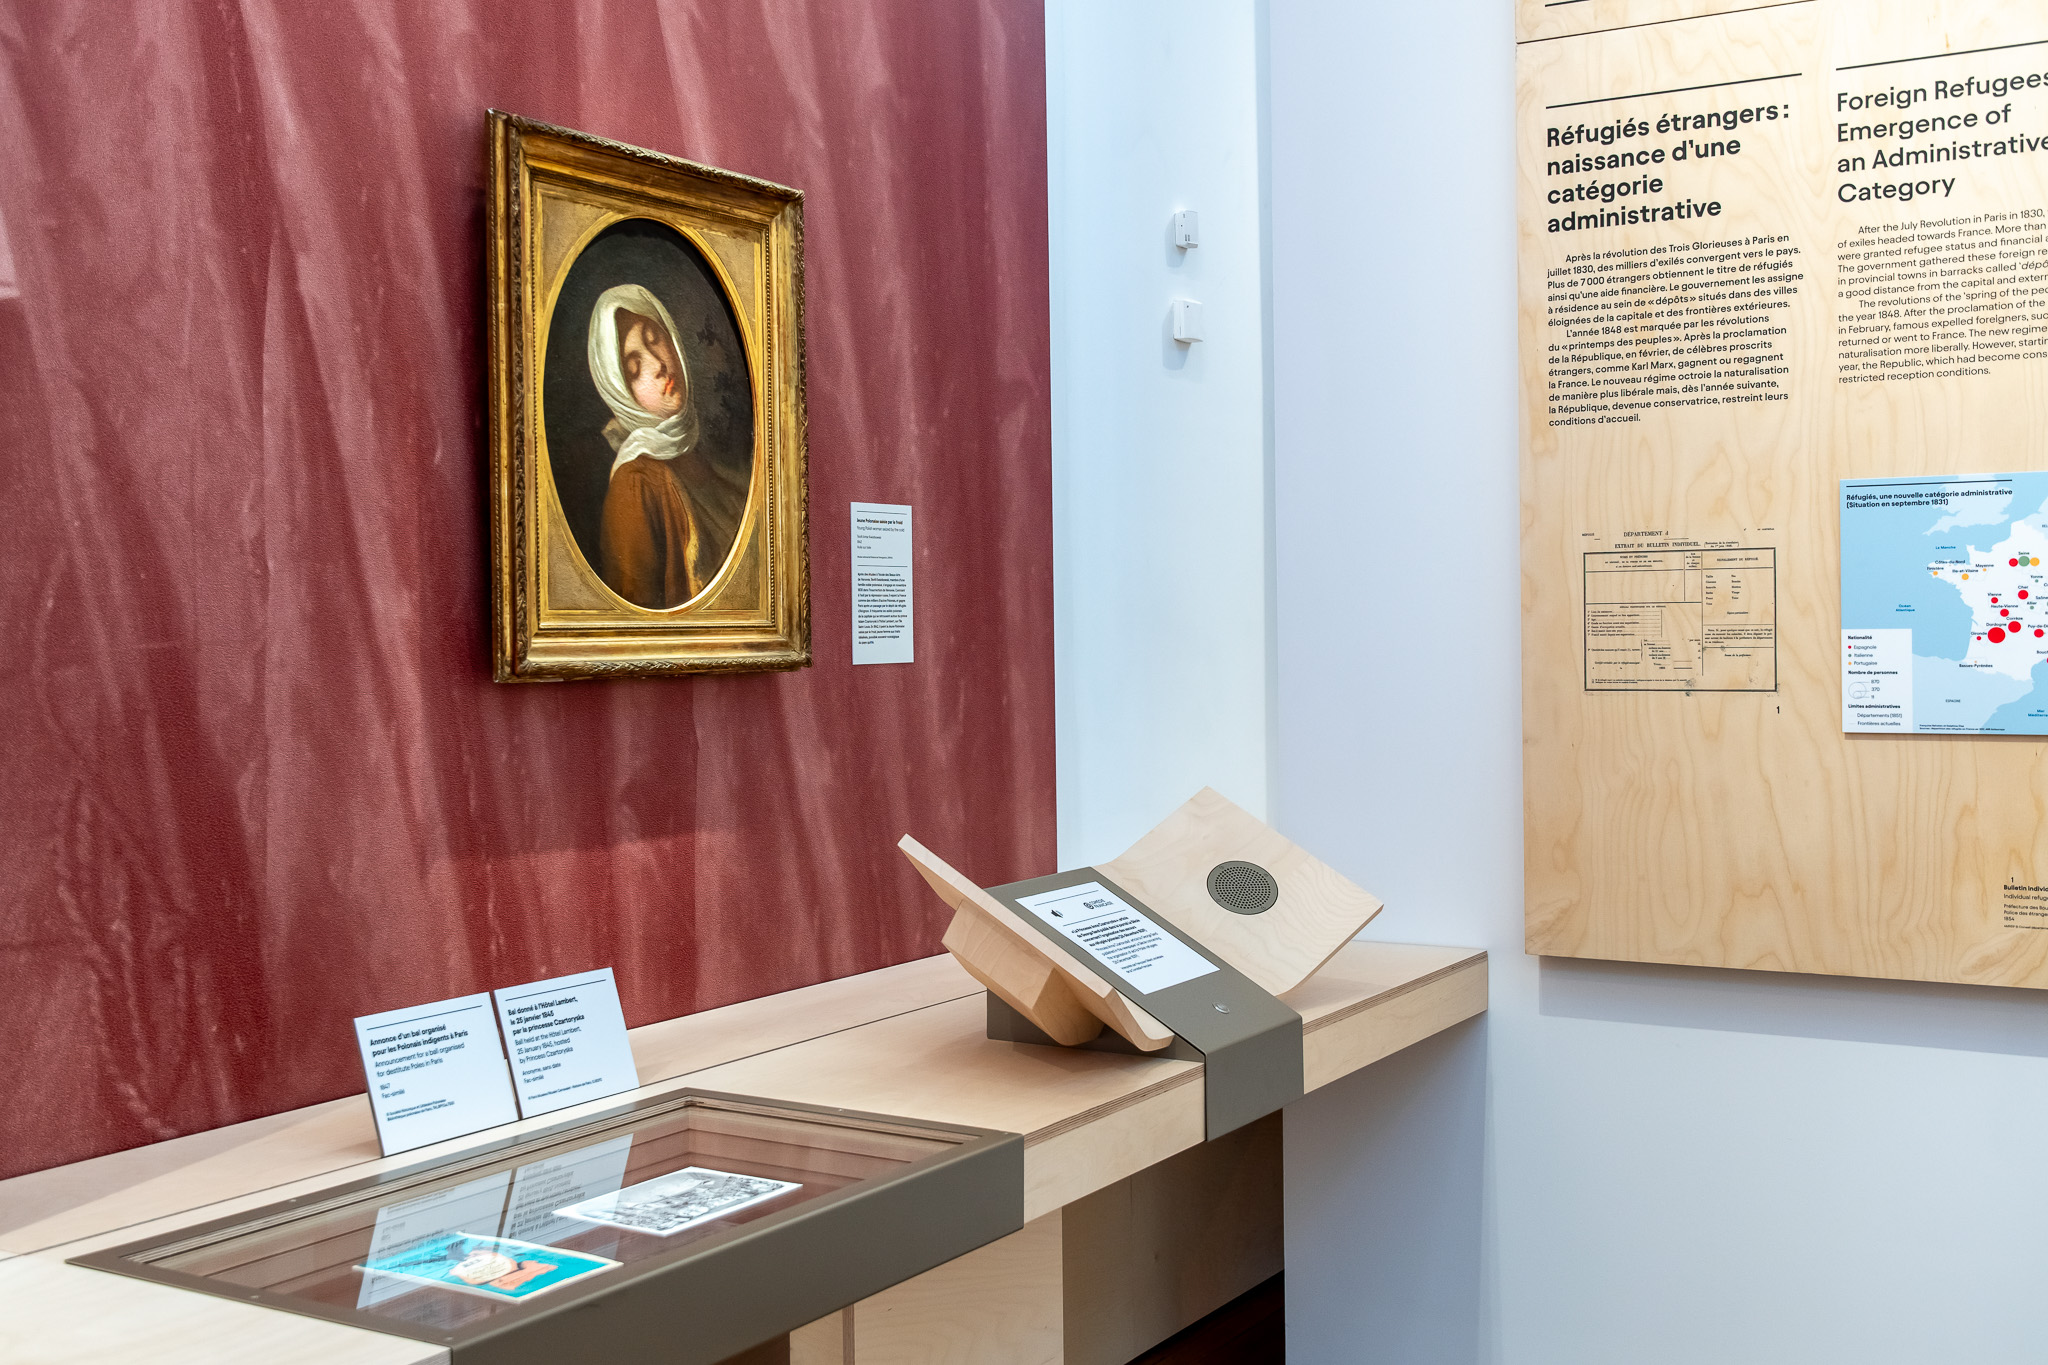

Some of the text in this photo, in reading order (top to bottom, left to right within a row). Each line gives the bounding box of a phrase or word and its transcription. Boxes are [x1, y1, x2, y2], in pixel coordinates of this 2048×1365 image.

[1837, 87, 1927, 112] Foreign
[1547, 118, 1649, 147] Réfugiés
[1656, 104, 1778, 134] étrangers
[1837, 103, 2012, 142] Emergence of
[1547, 140, 1741, 176] naissance d'une
[1838, 156, 1865, 172] an
[1547, 174, 1664, 204] catégorie
[1838, 178, 1956, 202] Category
[1548, 199, 1722, 233] administrative
[1858, 209, 2045, 234] After the July Revolution in Paris in 1830,
[1565, 253, 1591, 264] Après
[1593, 252, 1600, 260] la
[1603, 248, 1648, 259] révolution
[1650, 246, 1667, 255] des
[1669, 243, 1690, 253] Trois
[1692, 240, 1742, 251] Glorieuses
[1745, 237, 1750, 246] à
[1753, 235, 1775, 245] Paris
[1547, 267, 1571, 279] juillet
[1573, 265, 1595, 275] 1830,
[1597, 264, 1614, 272] des
[1616, 261, 1648, 271] milliers
[1650, 257, 1684, 267] d'exilés
[1686, 251, 1741, 264] convergent
[1765, 248, 1774, 257] le
[1776, 248, 1801, 257] pays.
[1548, 368, 1593, 377] étrangers,
[1595, 365, 1630, 373] comme
[1632, 362, 1648, 371] Karl
[1651, 361, 1676, 369] Marx,
[1678, 357, 1717, 369] gagnent
[1734, 352, 1783, 365] regagnent
[1839, 367, 1990, 383] restricted reception conditions.
[1549, 393, 1788, 414] la République, devenue conservatrice, restreint leurs
[1549, 413, 1640, 426] conditions d'accueil.
[1776, 706, 1780, 714] 1
